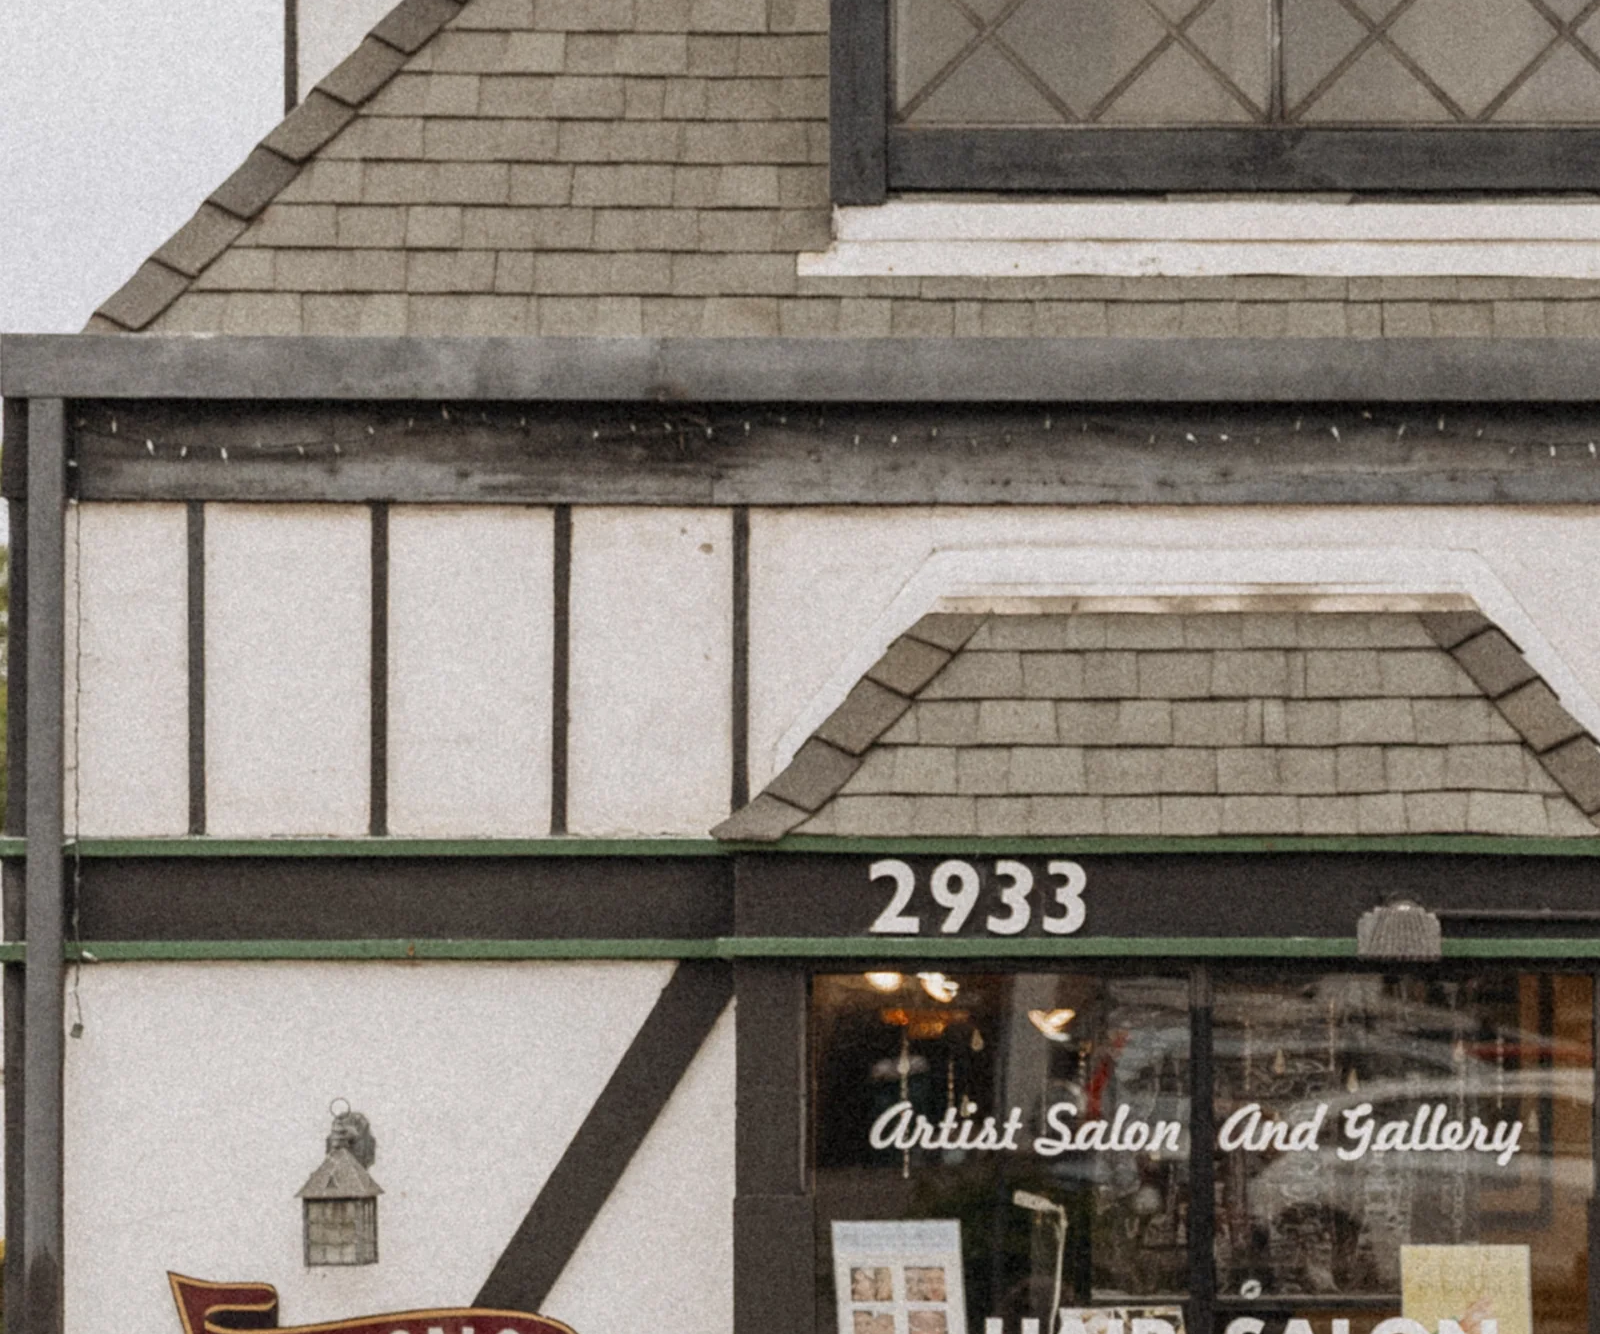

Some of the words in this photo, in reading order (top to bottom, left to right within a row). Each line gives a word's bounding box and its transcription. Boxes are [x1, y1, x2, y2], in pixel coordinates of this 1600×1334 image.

[869, 860, 1088, 935] 2933
[869, 1102, 1022, 1151] Artist
[1033, 1104, 1181, 1156] Salon
[1218, 1104, 1320, 1151] And
[1338, 1104, 1523, 1165] Gallery
